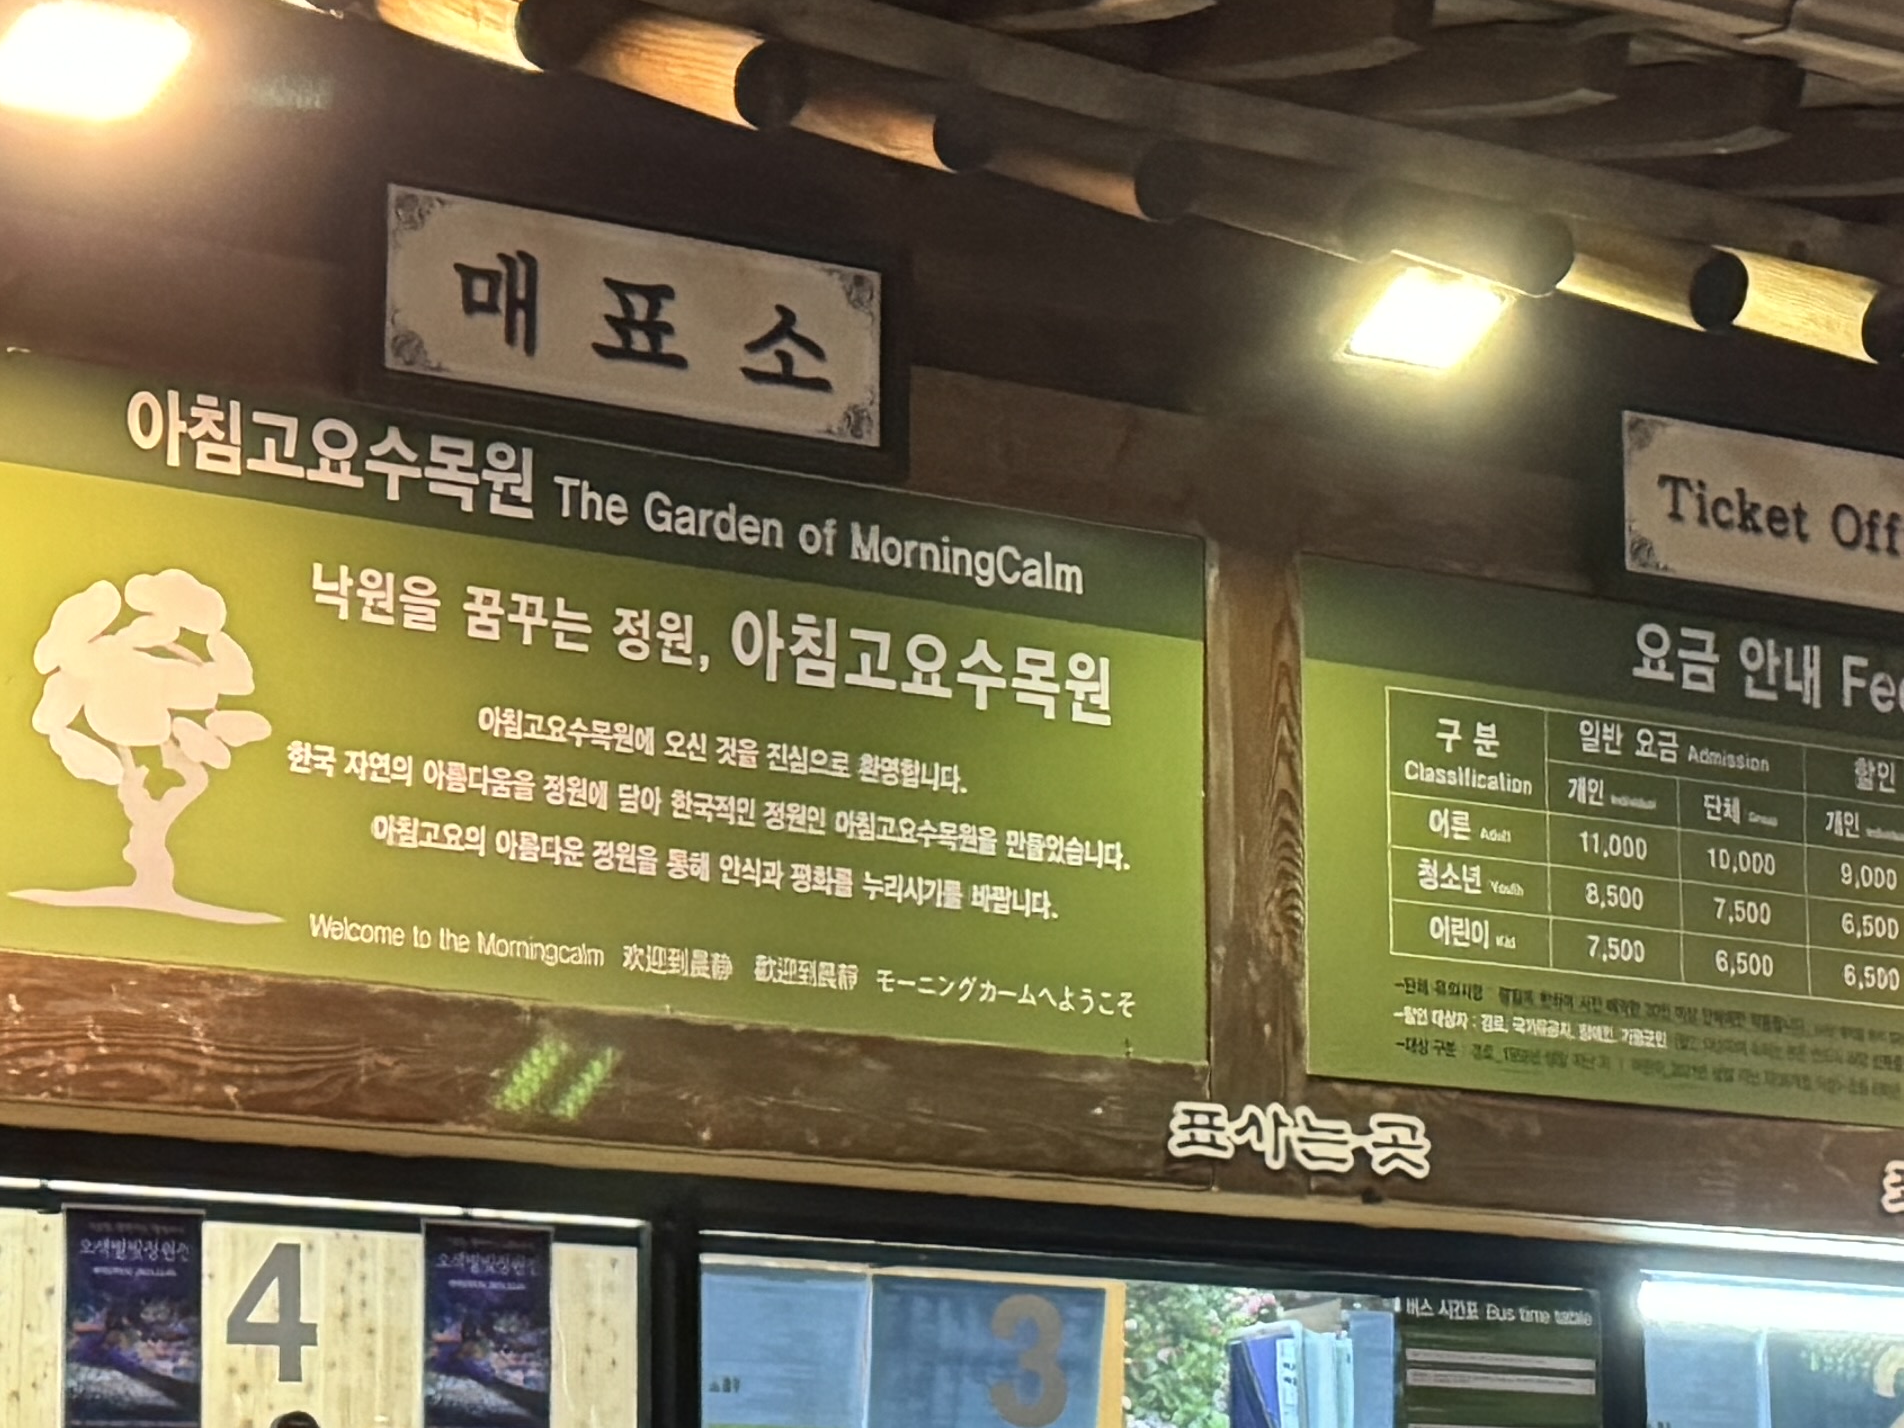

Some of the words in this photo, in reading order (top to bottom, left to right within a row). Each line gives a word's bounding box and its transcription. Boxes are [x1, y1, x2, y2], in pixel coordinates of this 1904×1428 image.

[128, 390, 534, 520] 아침고요수목원
[554, 475, 628, 526] The
[643, 491, 784, 549] Garden
[799, 518, 836, 556] of
[851, 521, 1083, 595] MorningCalm
[1657, 473, 1810, 545] Ticket
[313, 562, 441, 632] 낙원을
[463, 585, 593, 653] 꿈꾸는
[613, 607, 709, 672] 정원,
[731, 610, 1112, 726] 아침고요수목원
[1633, 623, 1719, 693] 요금
[1739, 637, 1821, 709] 안내
[478, 705, 654, 756] 아침고요수목원에
[663, 730, 707, 762] 오신
[715, 736, 759, 769] 것을
[766, 742, 851, 778] 진심으로
[857, 753, 967, 794] 환영합니다.
[1579, 719, 1623, 755] 일반
[1635, 728, 1679, 764] 요금
[1687, 745, 1769, 772] Admission
[1404, 759, 1532, 795] Classification
[1568, 777, 1604, 806] 개인
[286, 740, 337, 778] 한국
[343, 749, 413, 787] 자연의
[422, 759, 536, 801] 아름다움을
[543, 774, 608, 811] 정원에
[618, 783, 662, 817] 담아
[762, 801, 826, 835] 정원인
[834, 809, 998, 856] 아침고요수목원을
[1703, 794, 1740, 825] 단체
[1429, 808, 1471, 841] 어른
[1825, 810, 1859, 838] 개인
[1579, 830, 1647, 860] 11,000
[1707, 847, 1775, 876] 10,000
[370, 814, 486, 857] 아침고요의
[495, 829, 585, 868] 아름다운
[592, 840, 658, 876] 정원을
[666, 848, 710, 882] 통해
[719, 854, 785, 890] 안식과
[789, 863, 853, 898] 평화를
[862, 870, 963, 910] 누리시기를
[970, 884, 1058, 920] 바랍니다.
[1418, 857, 1482, 894] 청소년
[1840, 862, 1897, 890] 9,000
[1585, 882, 1643, 910] 8,500
[1713, 896, 1771, 925] 7,500
[309, 912, 405, 947] Welcome
[412, 925, 431, 949] to
[439, 927, 470, 953] the
[477, 930, 604, 967] Morningcalm
[1429, 915, 1489, 950] 어린이
[1841, 913, 1899, 939] 6,500
[1587, 934, 1645, 962] 7,500
[1715, 949, 1773, 977] 6,500
[1843, 964, 1900, 991] 6,500
[226, 1243, 318, 1382] 4
[990, 1294, 1068, 1428] 3
